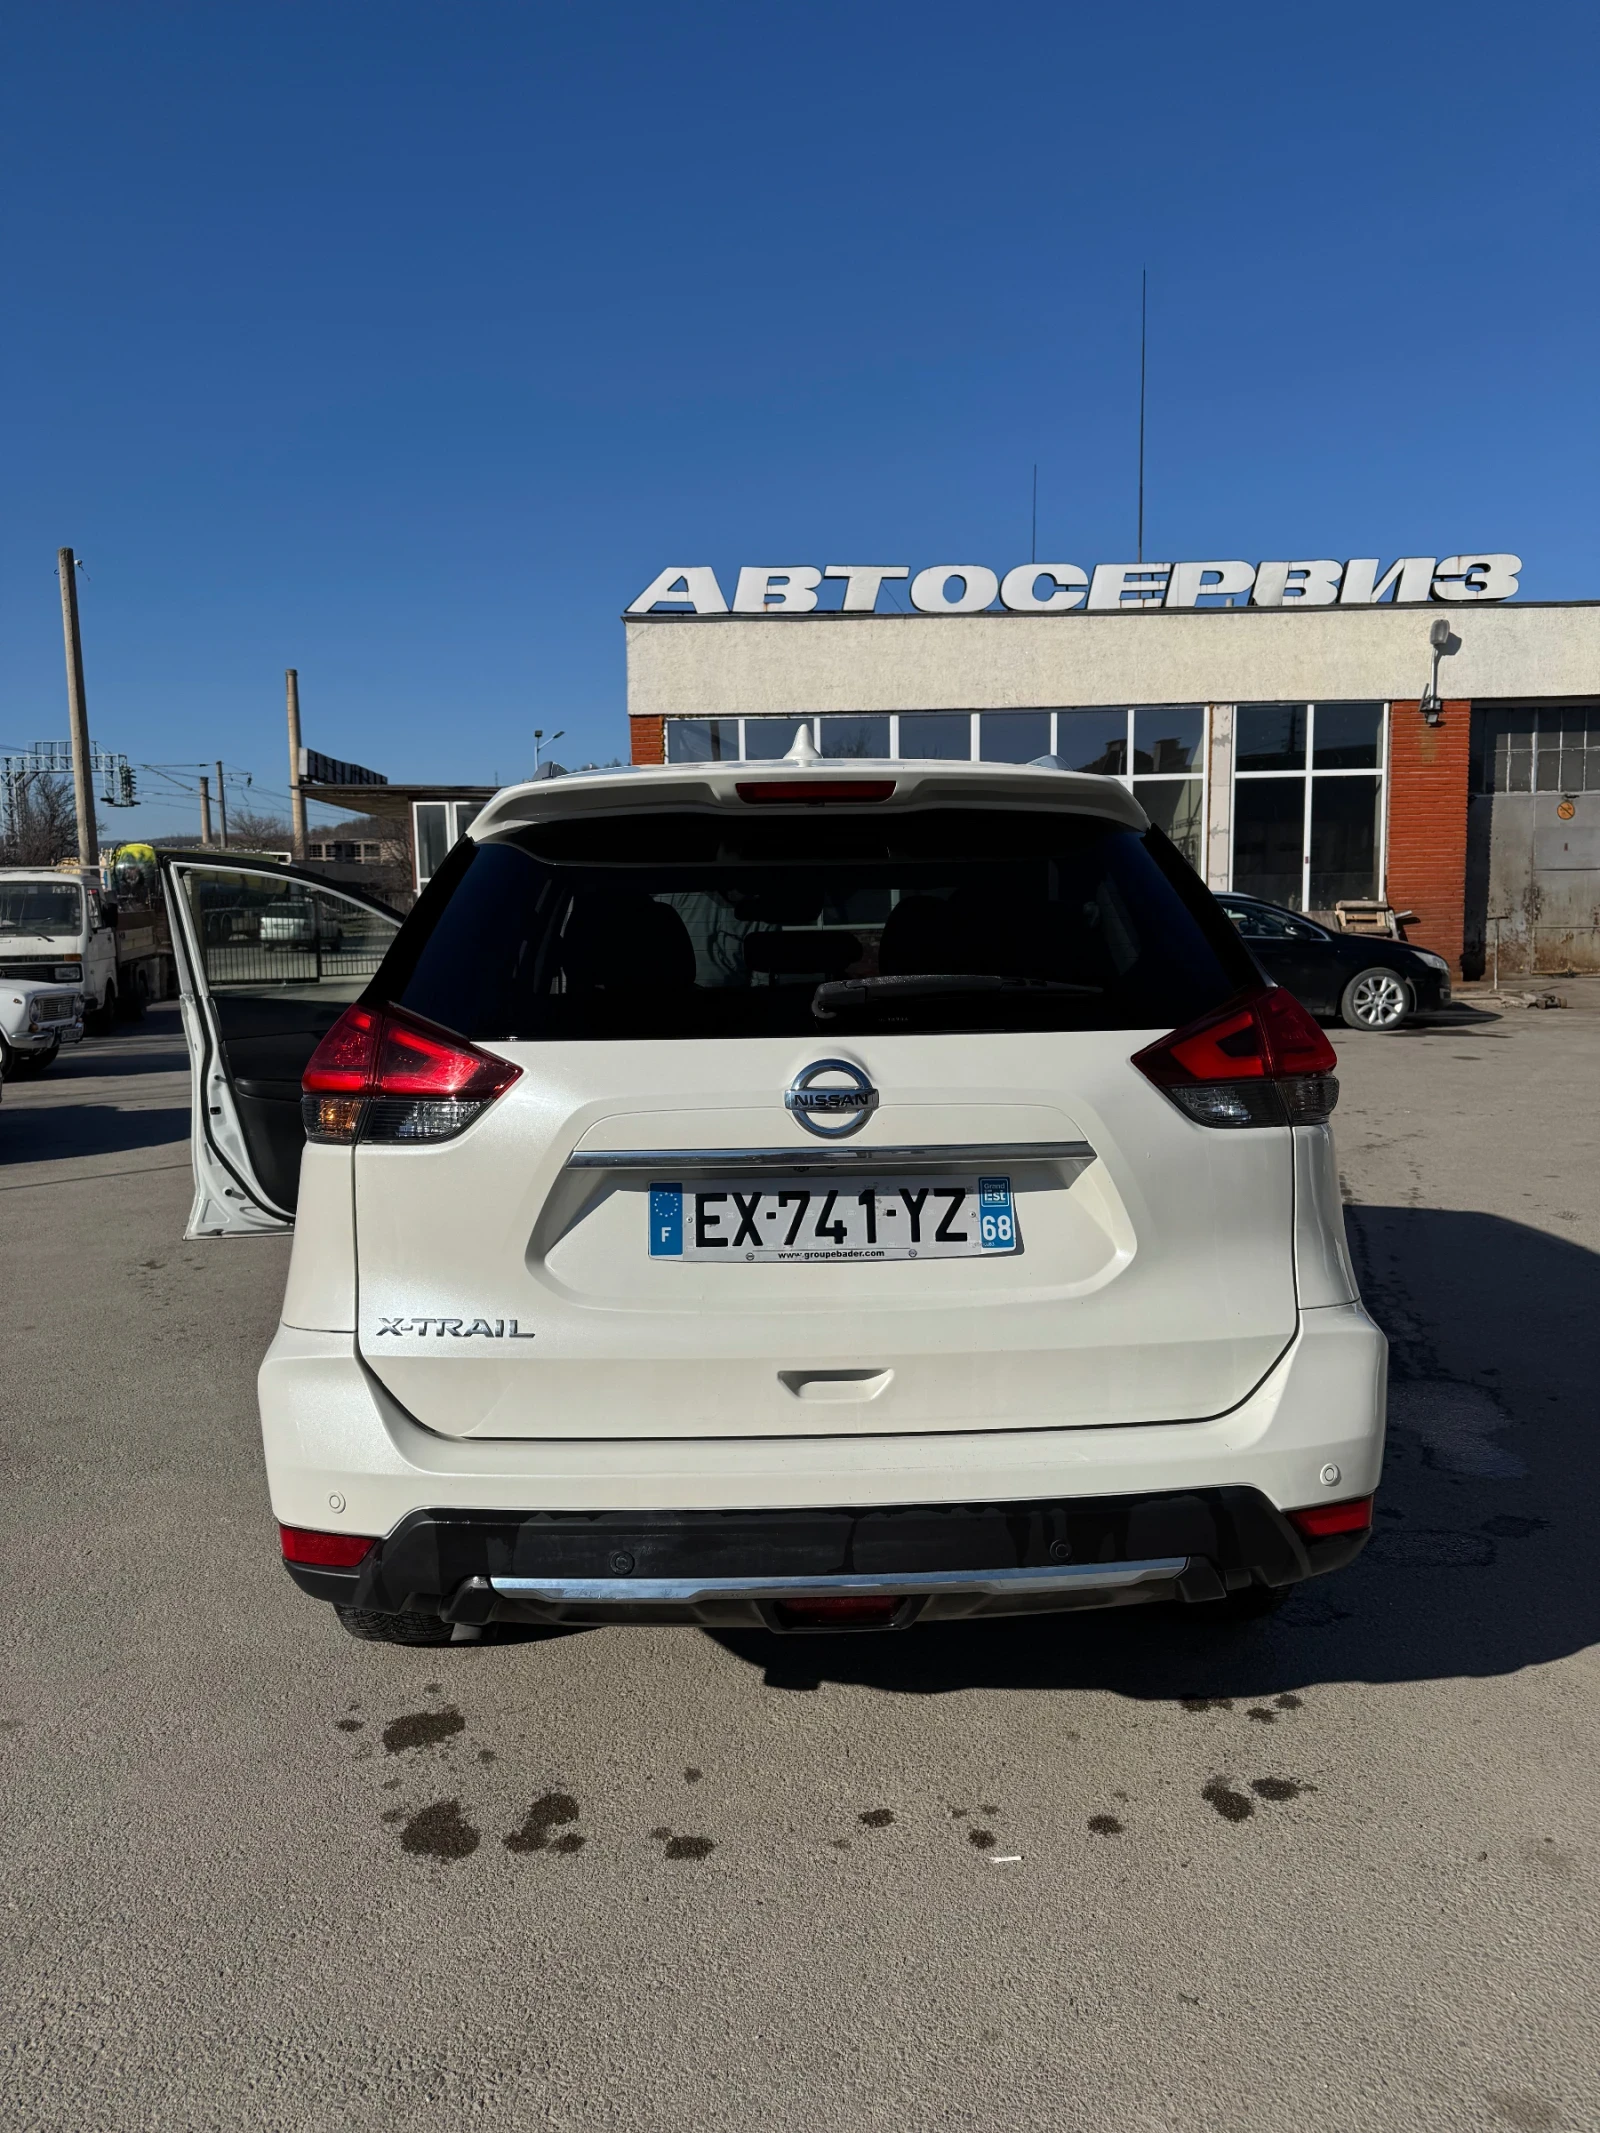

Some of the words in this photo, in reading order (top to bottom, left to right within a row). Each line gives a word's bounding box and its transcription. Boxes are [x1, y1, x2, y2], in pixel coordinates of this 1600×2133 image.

[627, 553, 1521, 614] АВТОСЕРВИЗ
[795, 1094, 868, 1106] NISSAN
[984, 1190, 1006, 1201] Est
[695, 1188, 968, 1248] EX-741-YZ
[661, 1227, 671, 1242] F
[982, 1215, 1012, 1241] 68
[778, 1250, 885, 1260] www.groupebader.com
[376, 1318, 536, 1338] X-TRAIL
